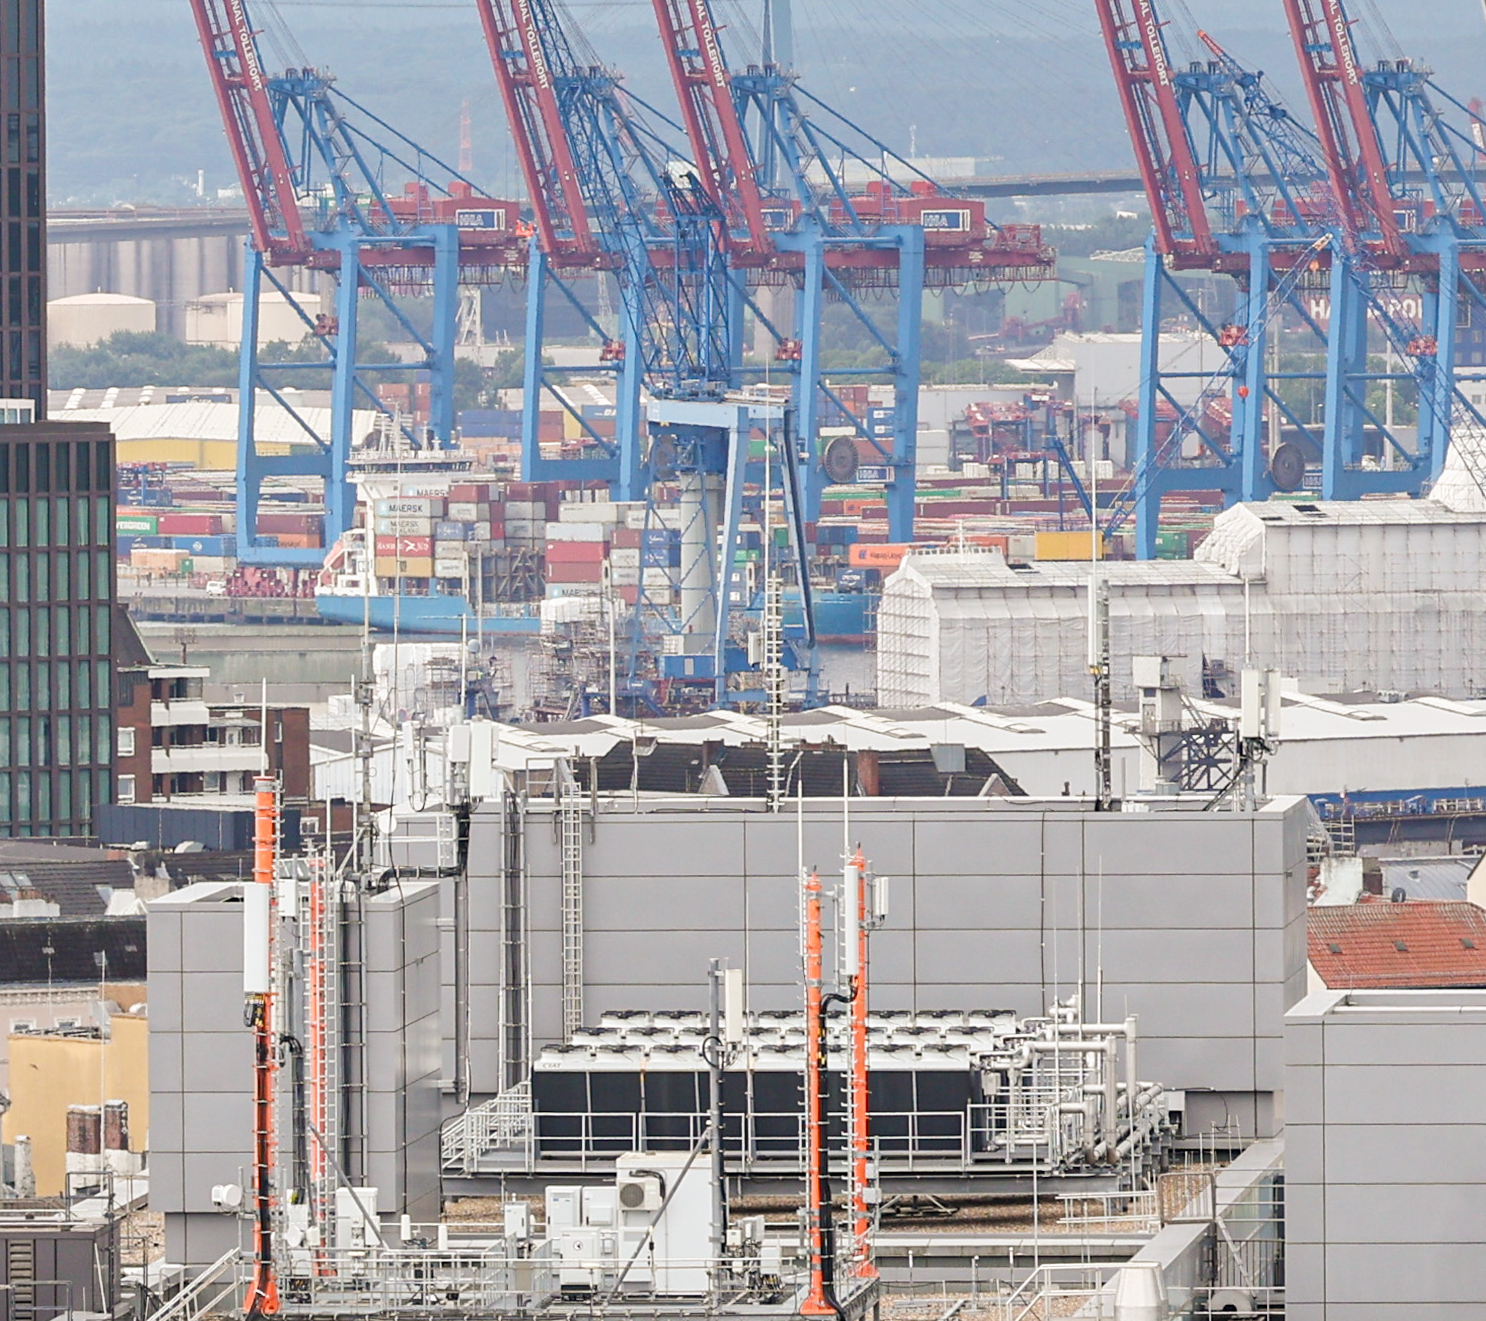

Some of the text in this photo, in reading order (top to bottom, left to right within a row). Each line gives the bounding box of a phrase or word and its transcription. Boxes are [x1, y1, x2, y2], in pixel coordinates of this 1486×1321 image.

[238, 26, 262, 91] TOLLERORT
[525, 24, 549, 89] TOLLERORT
[701, 21, 726, 88] TOLLERORT
[1144, 17, 1169, 86] TOLLERORT
[1333, 15, 1358, 85] TOLLERORT
[388, 504, 423, 512] MAERSK
